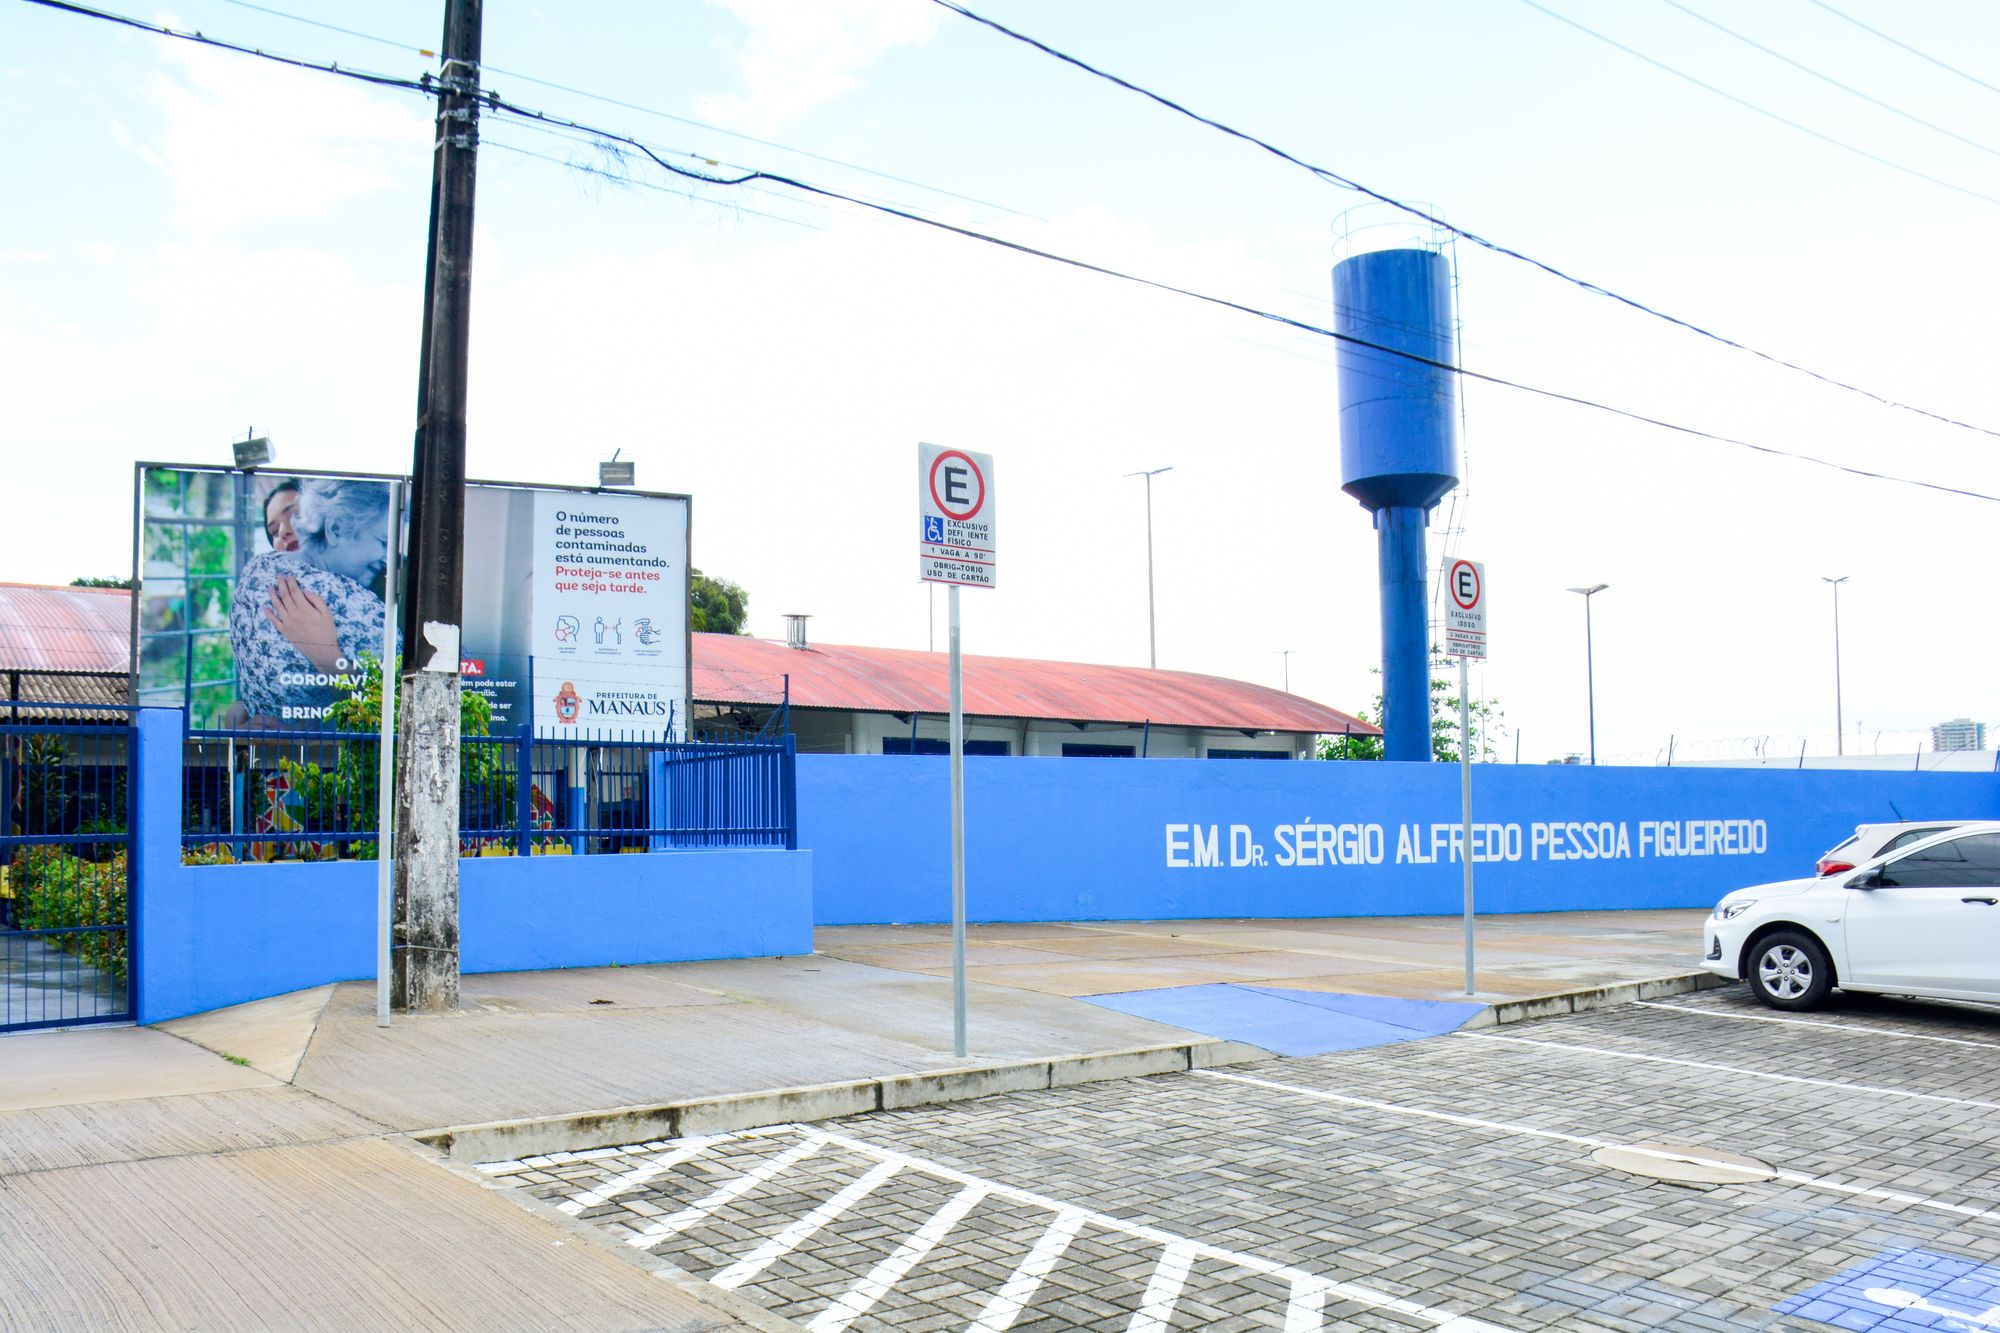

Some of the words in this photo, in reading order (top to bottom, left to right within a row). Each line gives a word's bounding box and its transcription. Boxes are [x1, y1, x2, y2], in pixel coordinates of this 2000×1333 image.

[945, 466, 970, 505] E
[556, 511, 567, 522] O
[570, 511, 619, 525] número
[556, 525, 570, 536] de
[574, 527, 625, 539] pessoas
[947, 520, 988, 532] EXCLUSIVO
[947, 529, 989, 541] DEFIIENTE
[555, 540, 647, 554] contaminadas
[940, 548, 961, 557] VAGA
[555, 552, 583, 564] está
[586, 555, 670, 568] aumentando.
[555, 565, 623, 580] Proteja-se
[625, 569, 660, 581] antes
[927, 569, 943, 577] USO
[555, 581, 578, 593] que
[581, 582, 607, 595] seja
[609, 582, 647, 594] tarde.
[1458, 571, 1473, 598] E
[1450, 611, 1482, 621] EXCLUSIVO
[335, 657, 348, 670] O
[460, 662, 481, 674] TA.
[475, 679, 494, 688] pode
[596, 692, 646, 700] PREFEITURA
[588, 699, 666, 716] MANAUS
[1166, 823, 1224, 868] E.M.
[1274, 816, 1384, 866] SÉRGIO
[1395, 823, 1522, 864] ALFREDO
[1532, 822, 1631, 861] PESSOA
[1639, 819, 1767, 857] FIGUEIREDO
